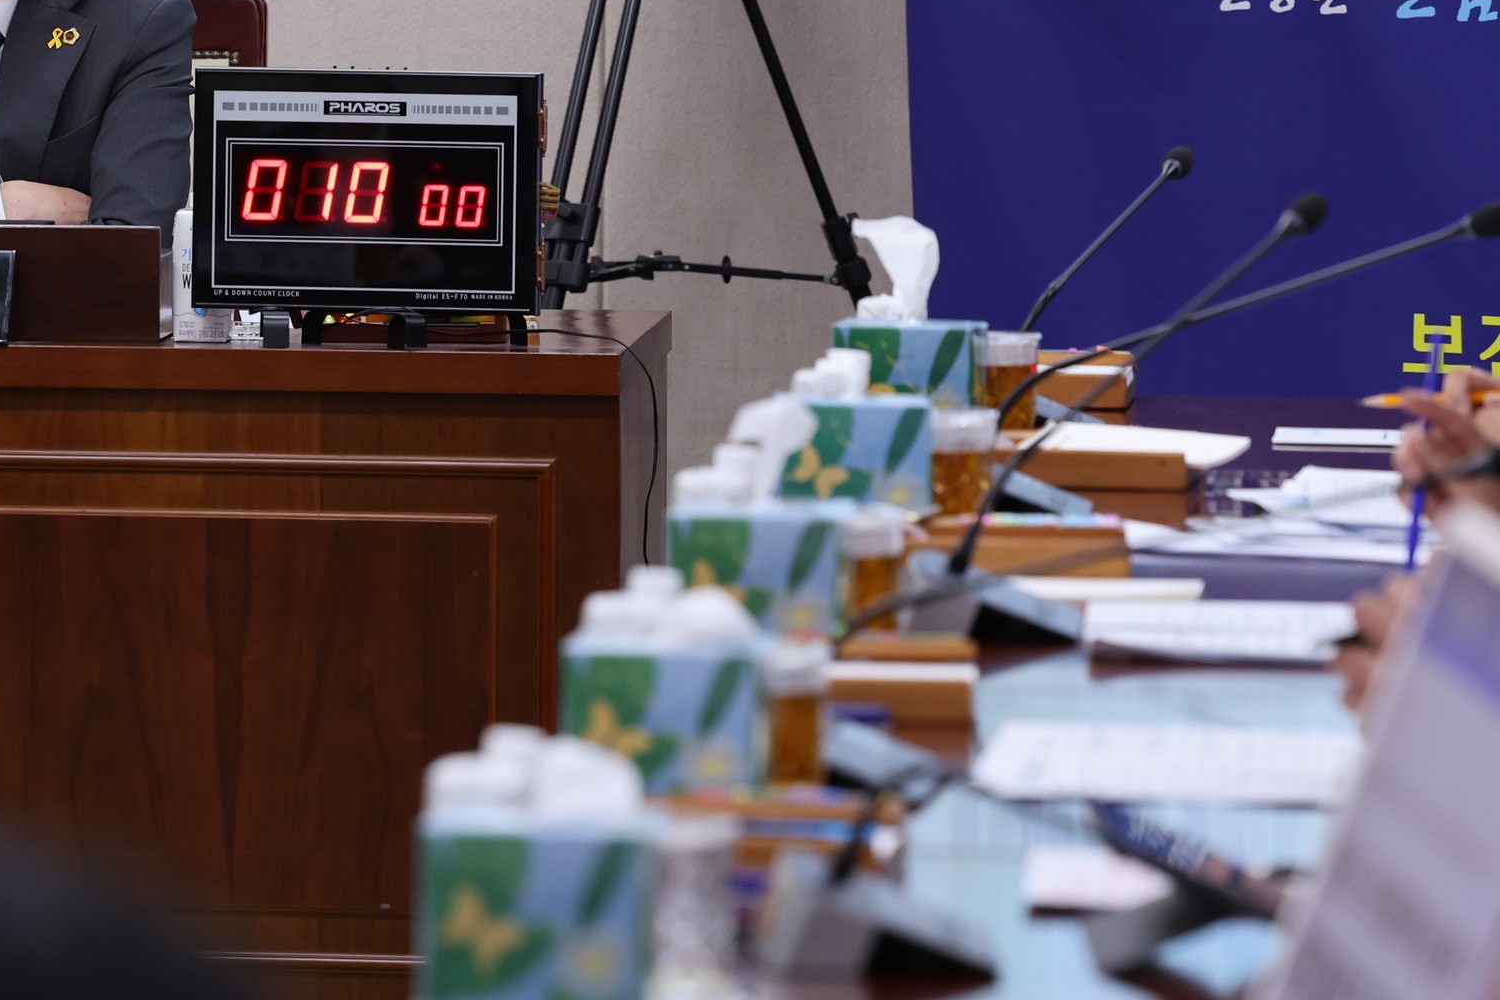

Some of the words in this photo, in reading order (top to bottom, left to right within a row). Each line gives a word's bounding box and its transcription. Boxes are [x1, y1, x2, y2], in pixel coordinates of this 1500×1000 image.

[328, 102, 401, 114] PHAROS
[231, 289, 252, 297] DOWN
[253, 289, 276, 297] COUNT
[277, 290, 300, 298] CLOCK
[415, 292, 439, 300] Digital
